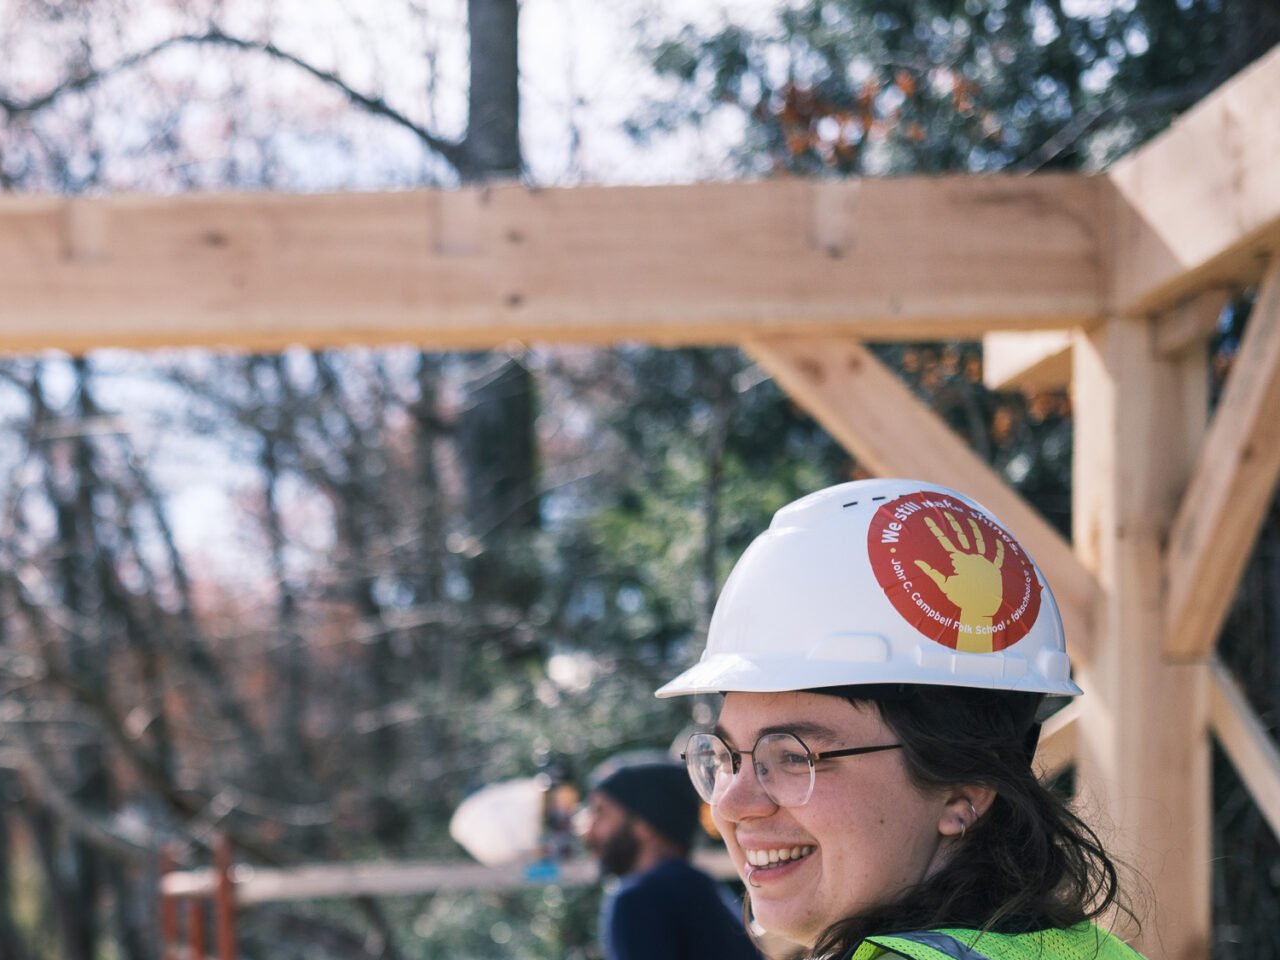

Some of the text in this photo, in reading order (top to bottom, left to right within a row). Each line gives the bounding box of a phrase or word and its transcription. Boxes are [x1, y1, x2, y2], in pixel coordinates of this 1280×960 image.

[881, 522, 902, 544] We
[894, 501, 922, 522] still
[921, 499, 963, 513] make
[891, 558, 1006, 635] John C. Campbell Folk School
[1010, 569, 1032, 623] folkschool.o
